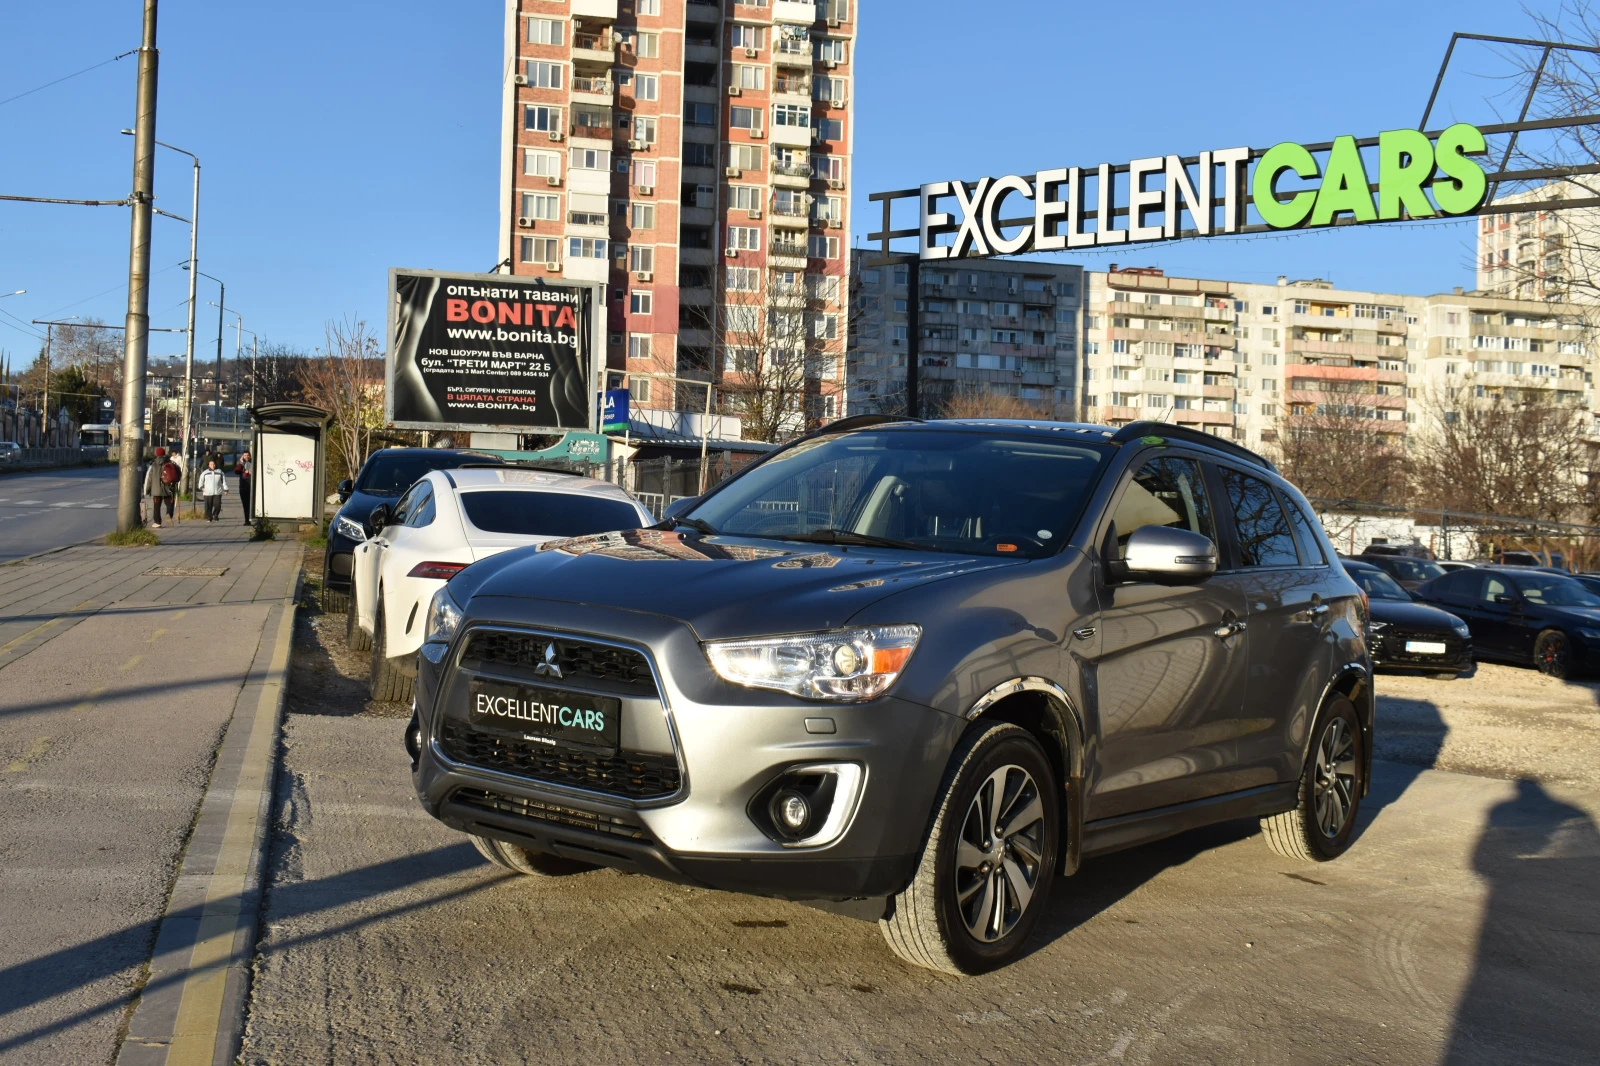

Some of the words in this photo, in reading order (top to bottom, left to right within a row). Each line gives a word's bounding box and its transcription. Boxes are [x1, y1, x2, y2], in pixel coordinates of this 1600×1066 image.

[446, 285, 519, 300] опънати
[523, 290, 579, 304] тавани
[446, 298, 577, 329] BONITA
[446, 327, 578, 348] www.bonita.bg
[428, 348, 449, 356] НОВ
[450, 349, 490, 358] ШОУРУМ
[514, 352, 545, 360] ВАРНА
[421, 357, 444, 367] бул.
[528, 362, 541, 371] 22
[543, 363, 551, 371] Б
[456, 394, 494, 402] ЦЯЛАТА
[496, 395, 536, 403] СТРАНА!
[447, 402, 536, 412] www.BONITA.bg
